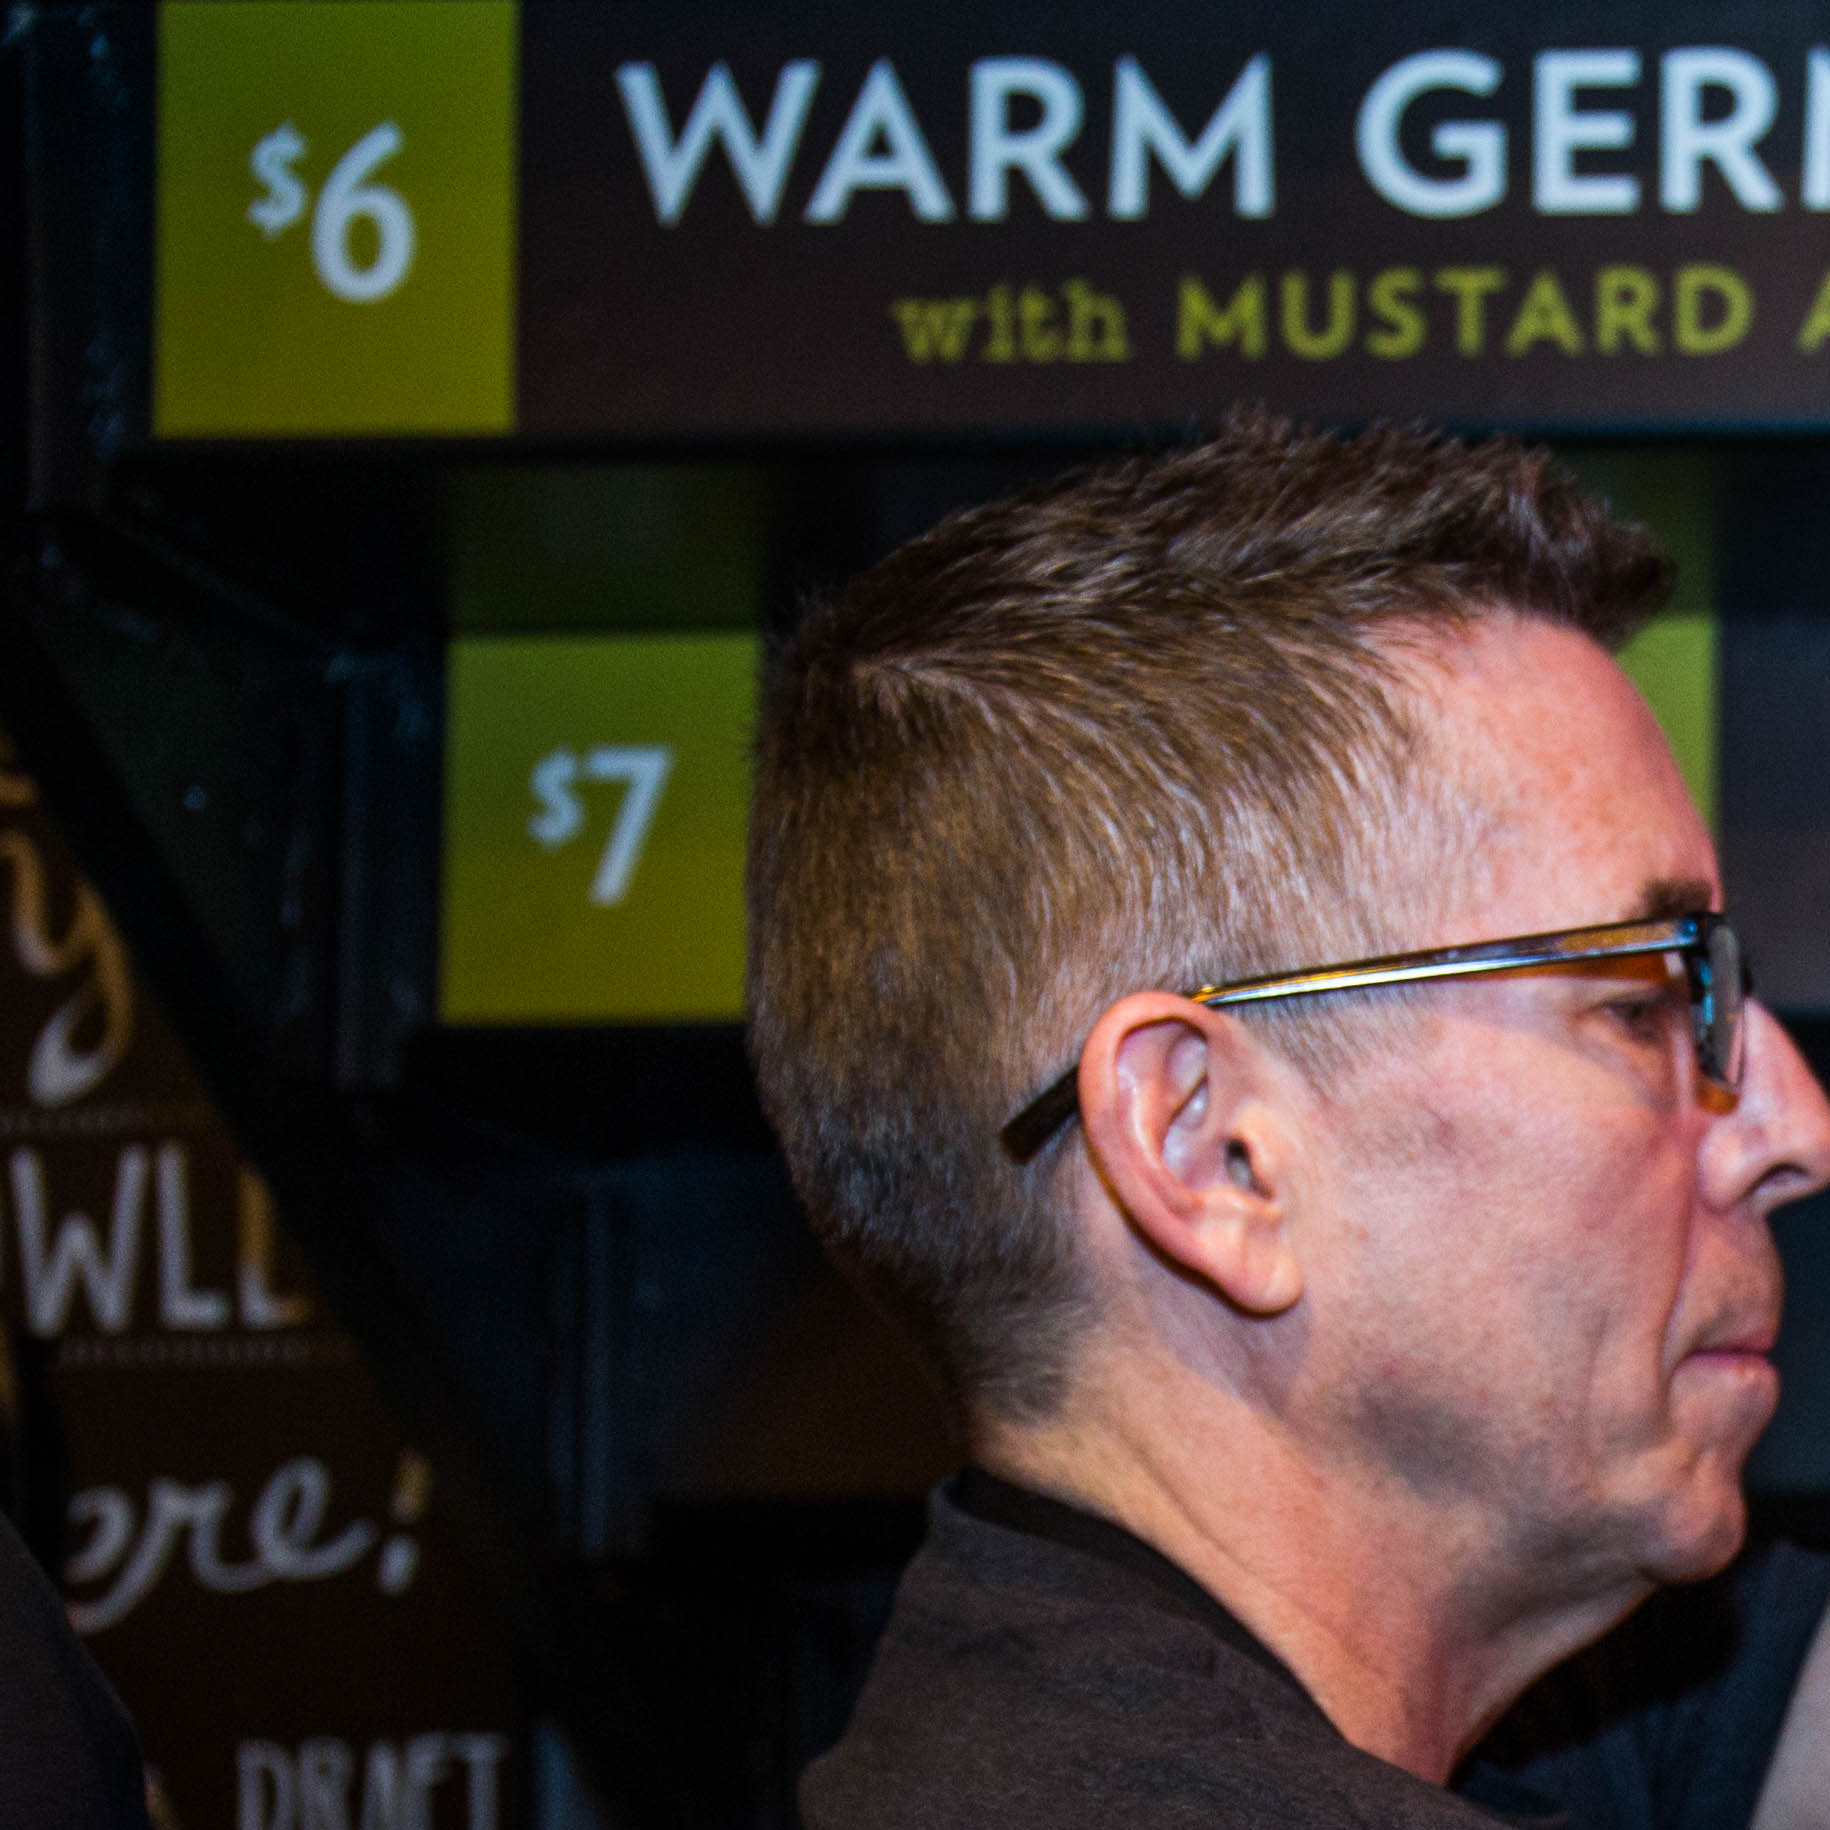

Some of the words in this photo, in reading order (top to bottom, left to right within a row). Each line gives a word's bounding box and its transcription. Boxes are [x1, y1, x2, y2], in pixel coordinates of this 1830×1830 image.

[248, 121, 417, 304] $6
[616, 58, 1275, 222] WARM
[888, 278, 1132, 364] with
[1176, 264, 1754, 362] MUSTARD
[527, 745, 674, 908] $7
